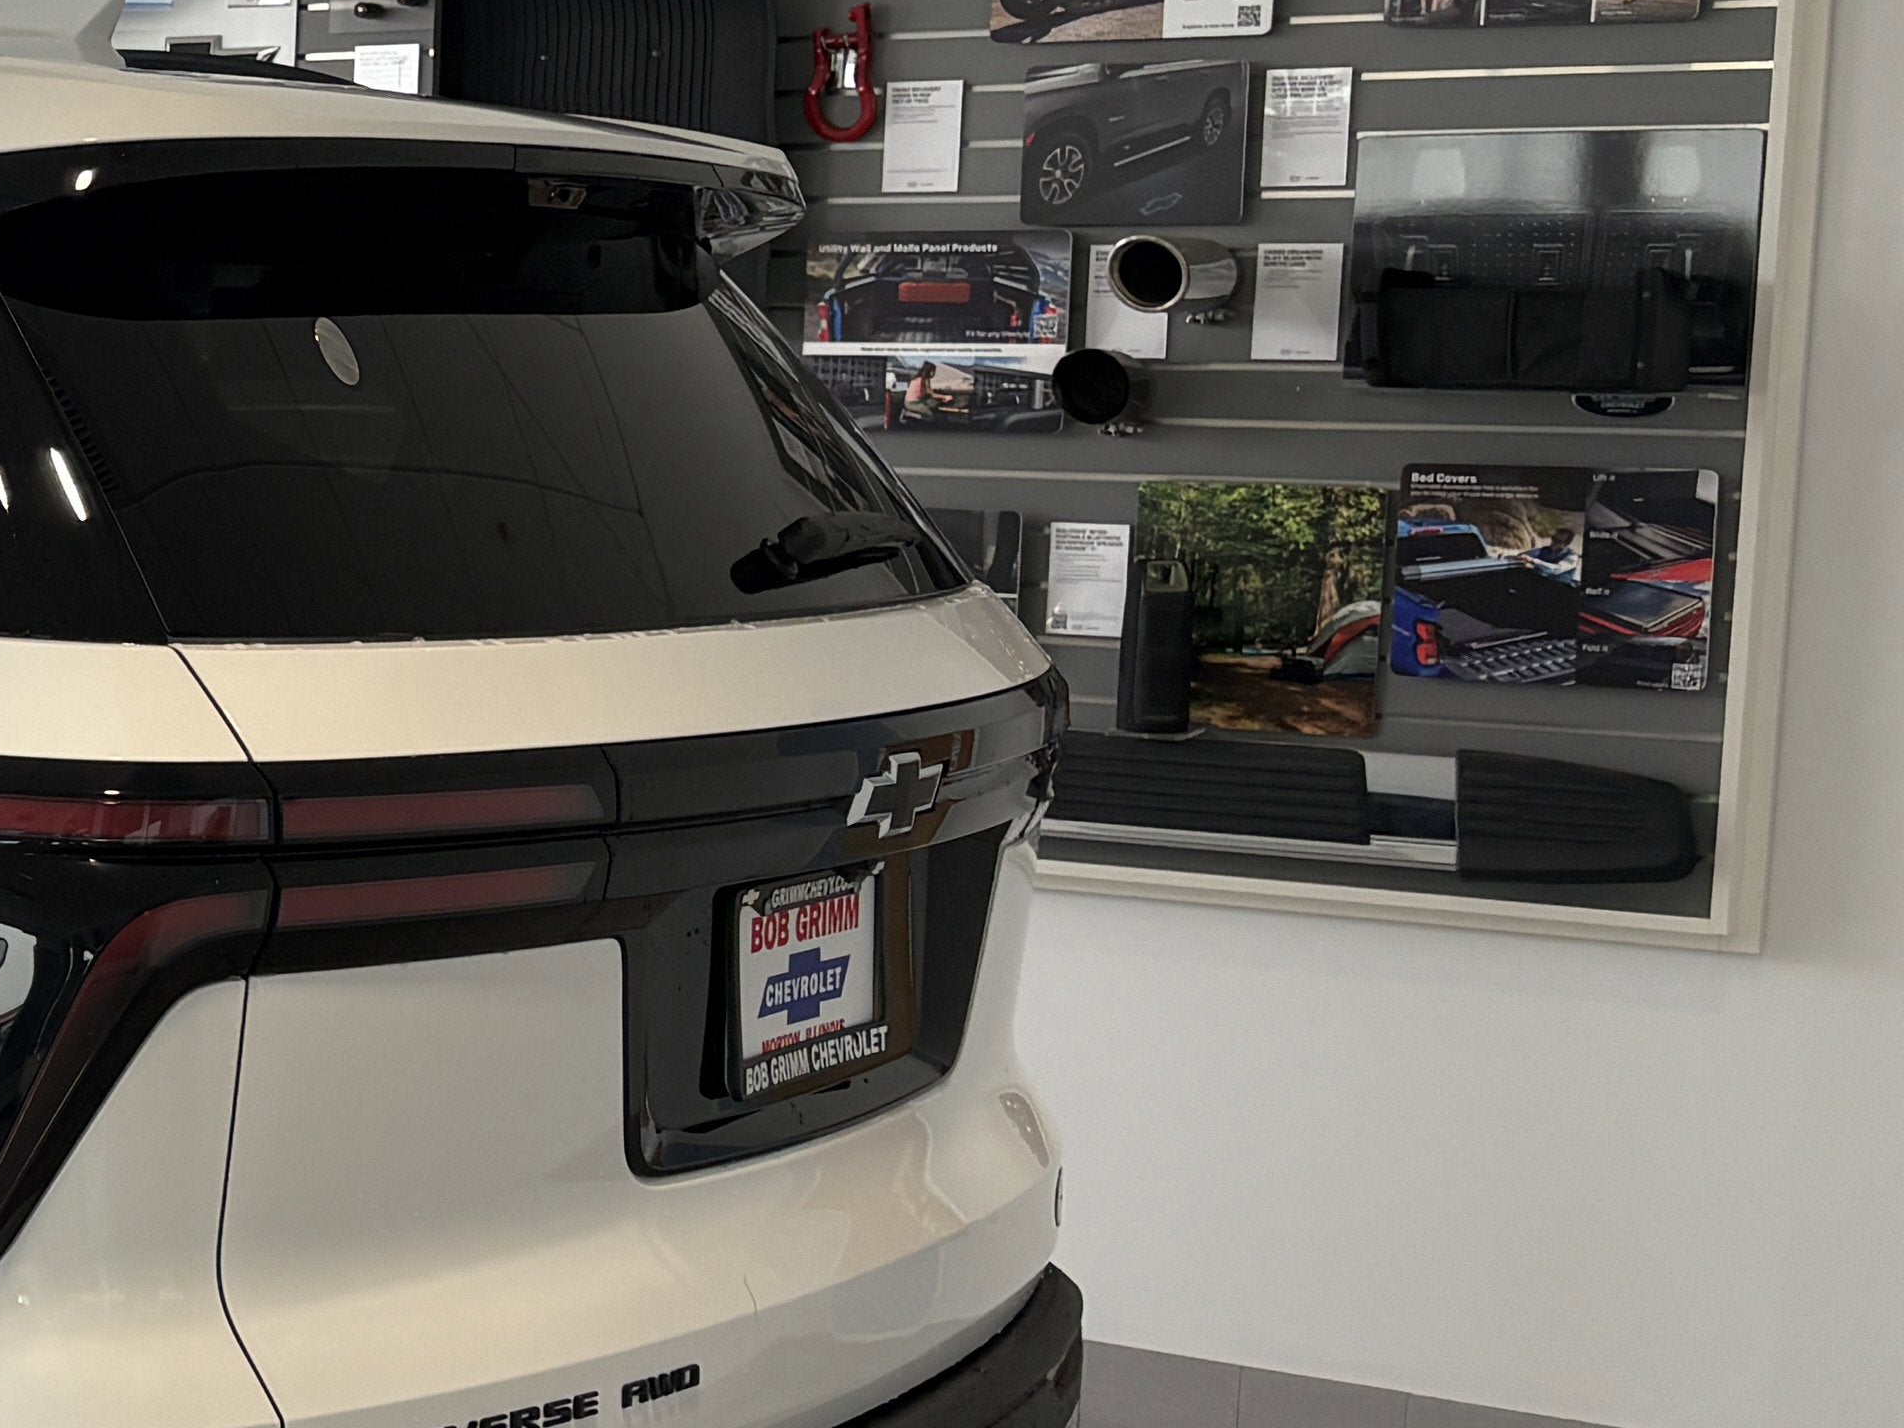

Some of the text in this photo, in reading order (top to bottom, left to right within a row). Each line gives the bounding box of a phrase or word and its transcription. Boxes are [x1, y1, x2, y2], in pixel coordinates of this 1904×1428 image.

[818, 244, 848, 255] Utility
[850, 244, 871, 254] Wall
[873, 244, 891, 253] and
[922, 243, 950, 253] Panel
[952, 243, 998, 253] Products
[1411, 472, 1478, 484] Bed Covers
[750, 893, 861, 954] BOB GRIMM
[765, 966, 843, 1008] CHEVROLET
[745, 1025, 889, 1096] BOB GRIMM CHEVROLET
[620, 1363, 701, 1410] AWD
